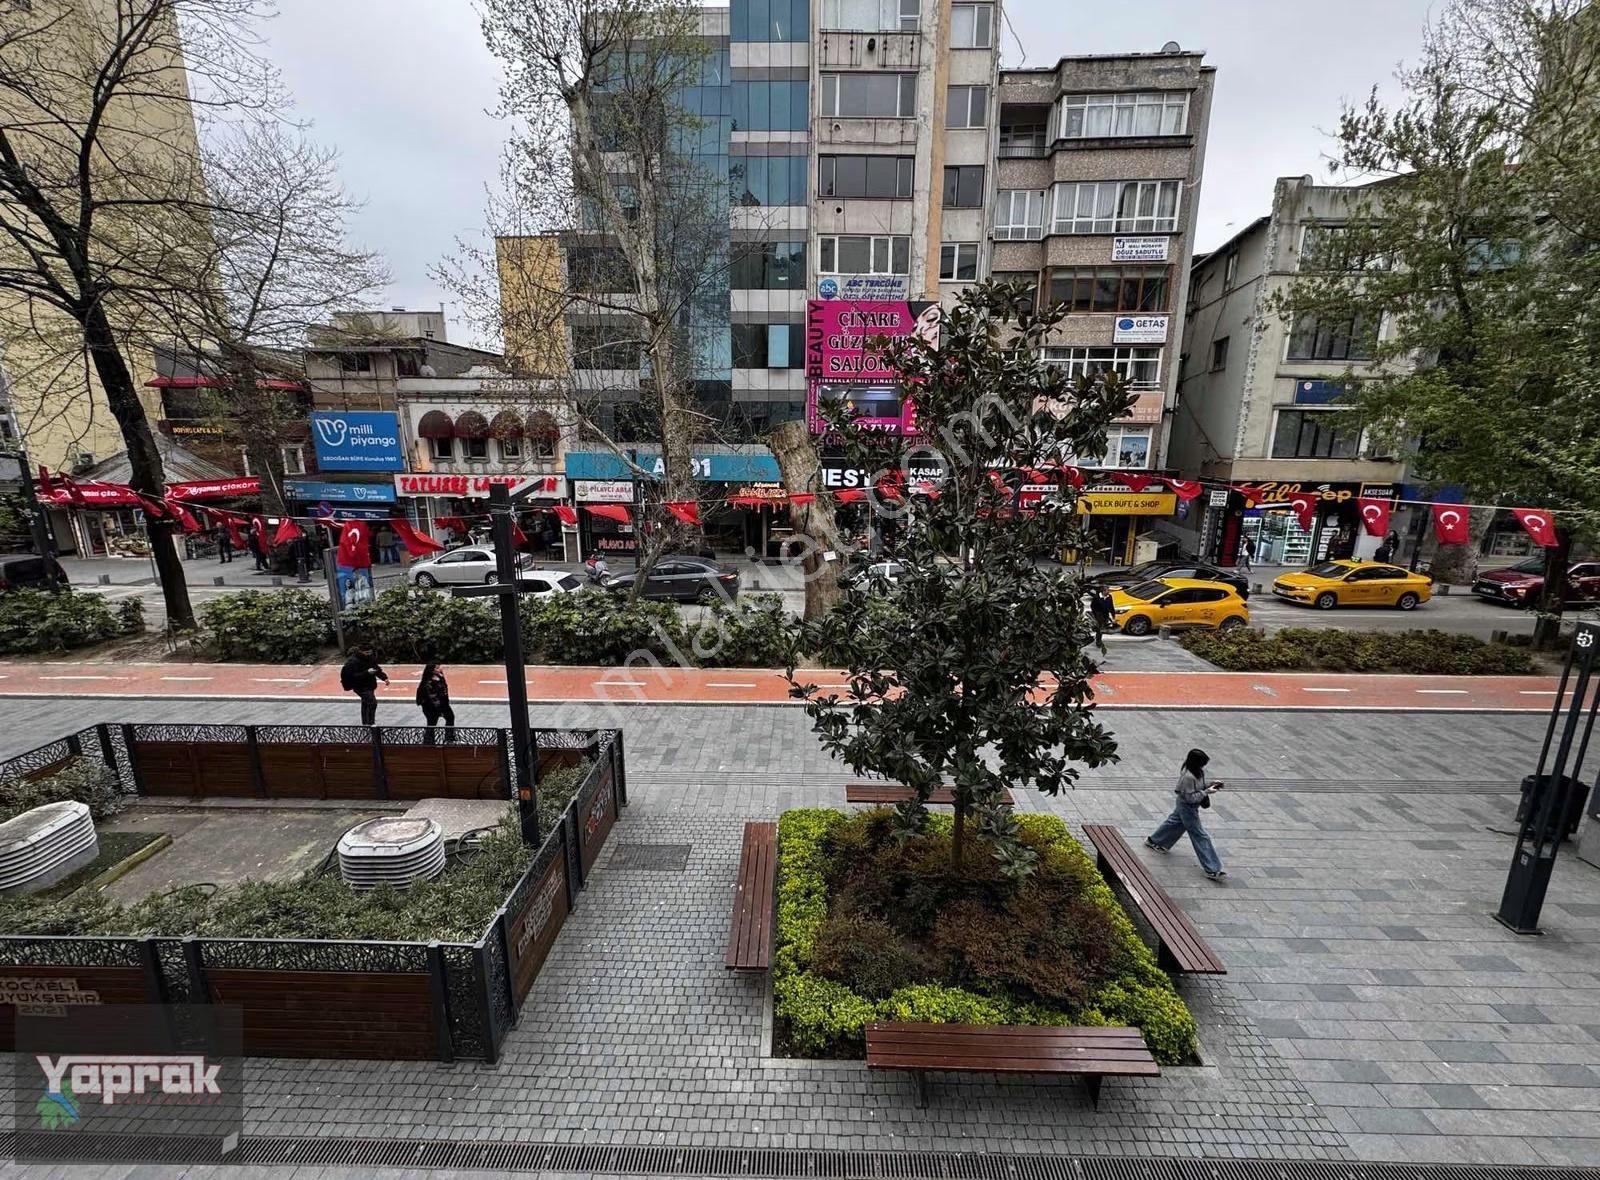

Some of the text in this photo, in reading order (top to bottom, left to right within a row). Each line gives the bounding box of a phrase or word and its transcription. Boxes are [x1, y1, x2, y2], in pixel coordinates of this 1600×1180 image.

[838, 307, 901, 329] ÇİNARE
[1136, 319, 1165, 329] GETAŞ
[808, 302, 825, 377] BEAUTY
[349, 424, 373, 434] milli
[350, 436, 396, 447] piyango
[909, 467, 943, 477] KASAP
[1093, 500, 1113, 509] ÇİLEK
[1133, 500, 1139, 508] &
[1140, 500, 1160, 508] SHOP
[20, 1004, 64, 1014] 2021
